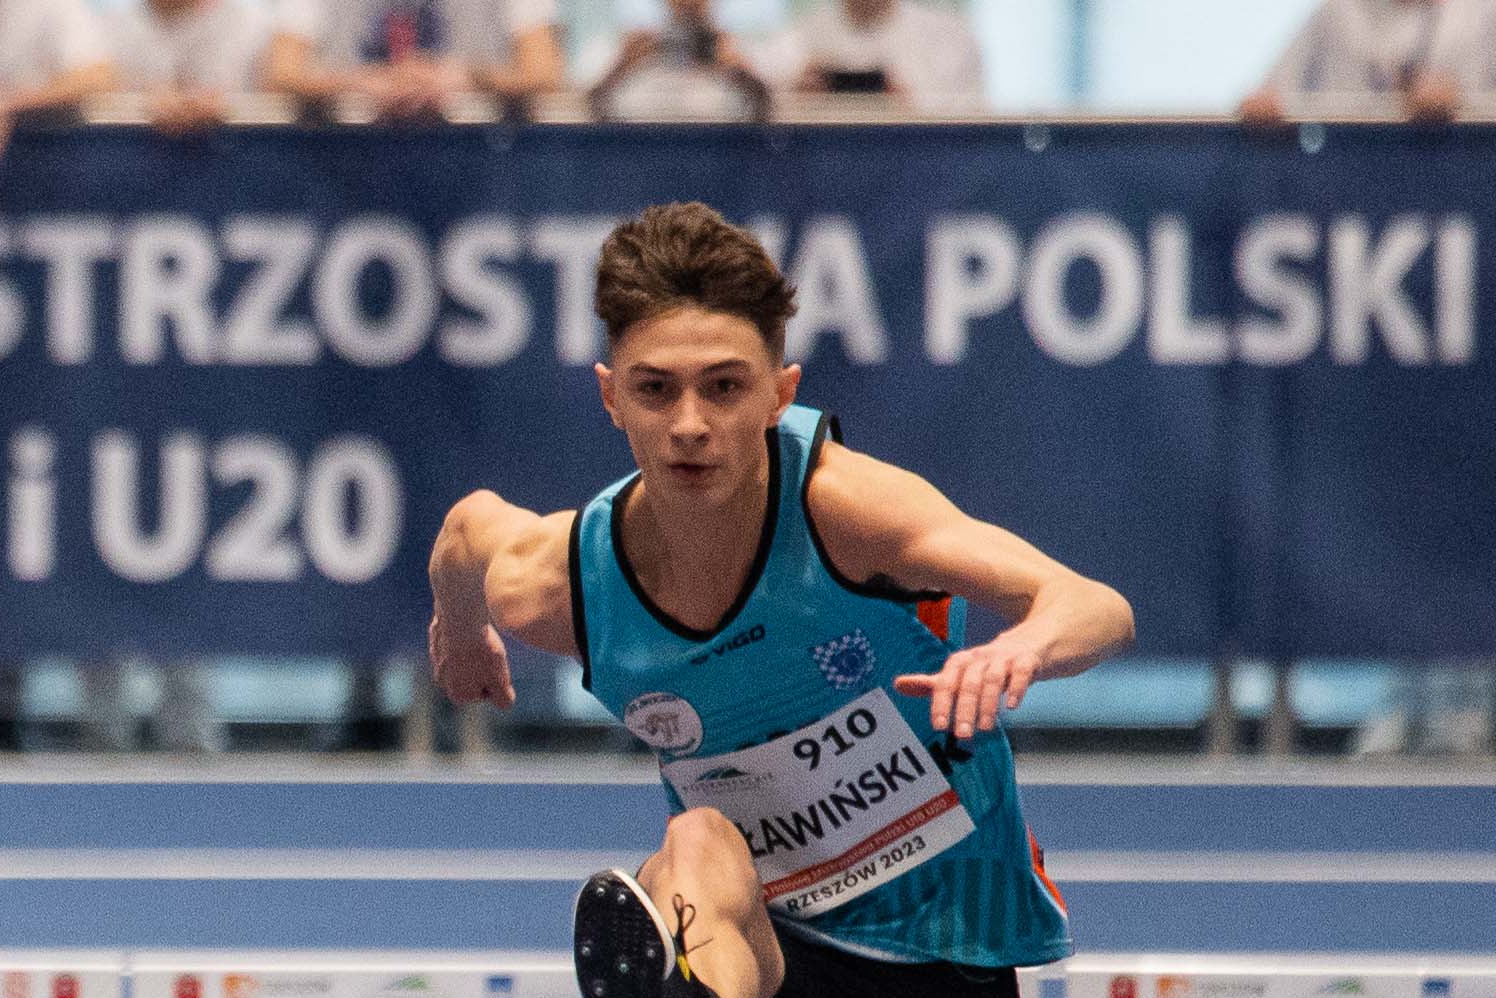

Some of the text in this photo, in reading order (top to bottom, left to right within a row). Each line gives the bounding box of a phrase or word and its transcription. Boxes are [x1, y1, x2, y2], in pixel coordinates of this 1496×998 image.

[924, 212, 1476, 364] POLSKI
[8, 430, 56, 580] i
[92, 432, 401, 582] U20
[792, 708, 878, 772] 910
[734, 745, 927, 858] ŁAWIŃSKI
[785, 835, 926, 913] RZESZÓW 2023
